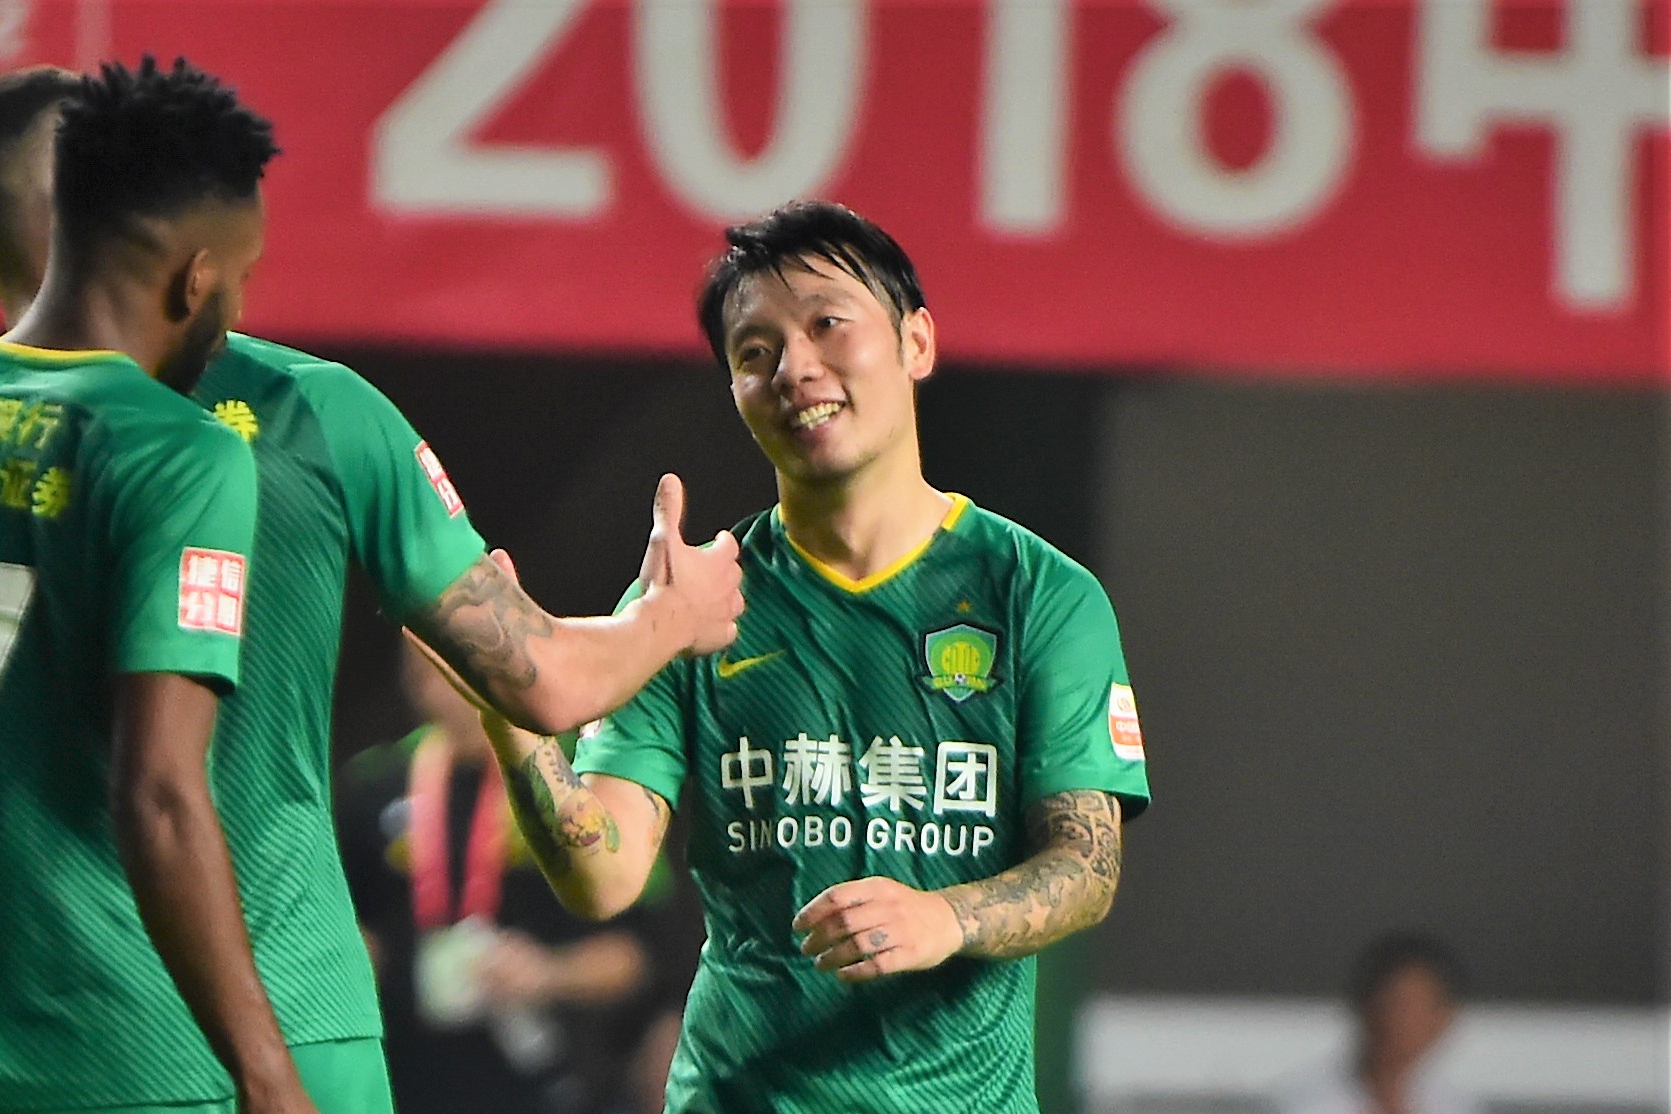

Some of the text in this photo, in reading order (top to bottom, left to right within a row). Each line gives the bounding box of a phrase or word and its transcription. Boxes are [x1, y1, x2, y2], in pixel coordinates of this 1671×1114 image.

[720, 732, 998, 817] 中赫集团
[727, 816, 995, 857] SINOBO GROUP
